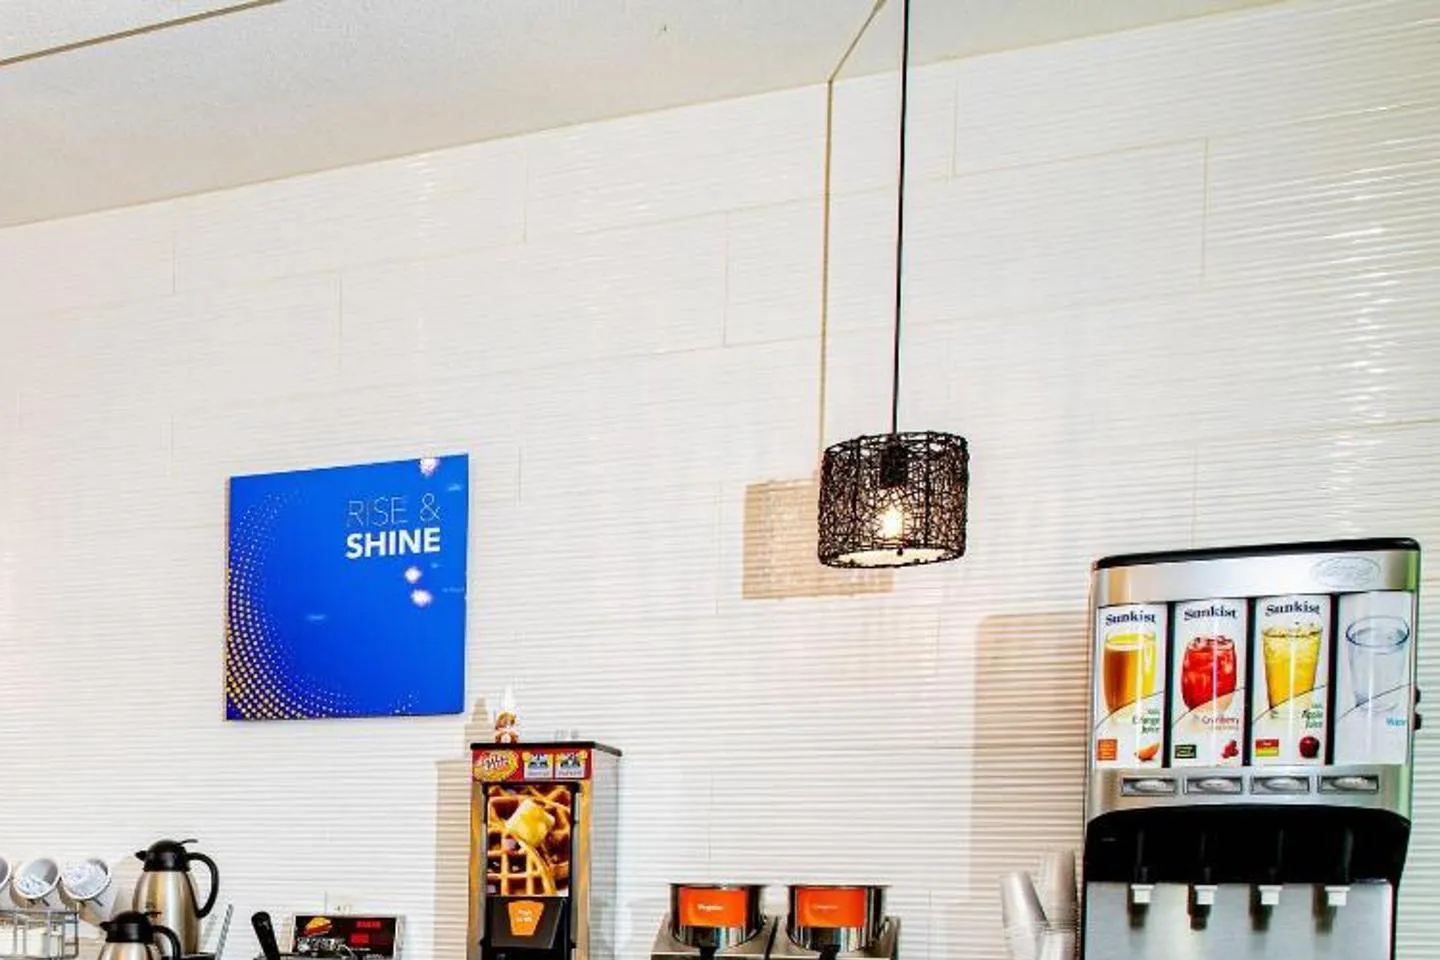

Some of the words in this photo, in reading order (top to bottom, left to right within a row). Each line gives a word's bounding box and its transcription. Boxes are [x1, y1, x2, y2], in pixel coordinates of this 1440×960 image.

[346, 496, 408, 527] RISE
[420, 493, 441, 522] &
[346, 527, 441, 559] SHINE
[1184, 605, 1236, 621] Sunkist
[1265, 600, 1320, 617] Sunkist
[1105, 610, 1156, 626] Sunkist
